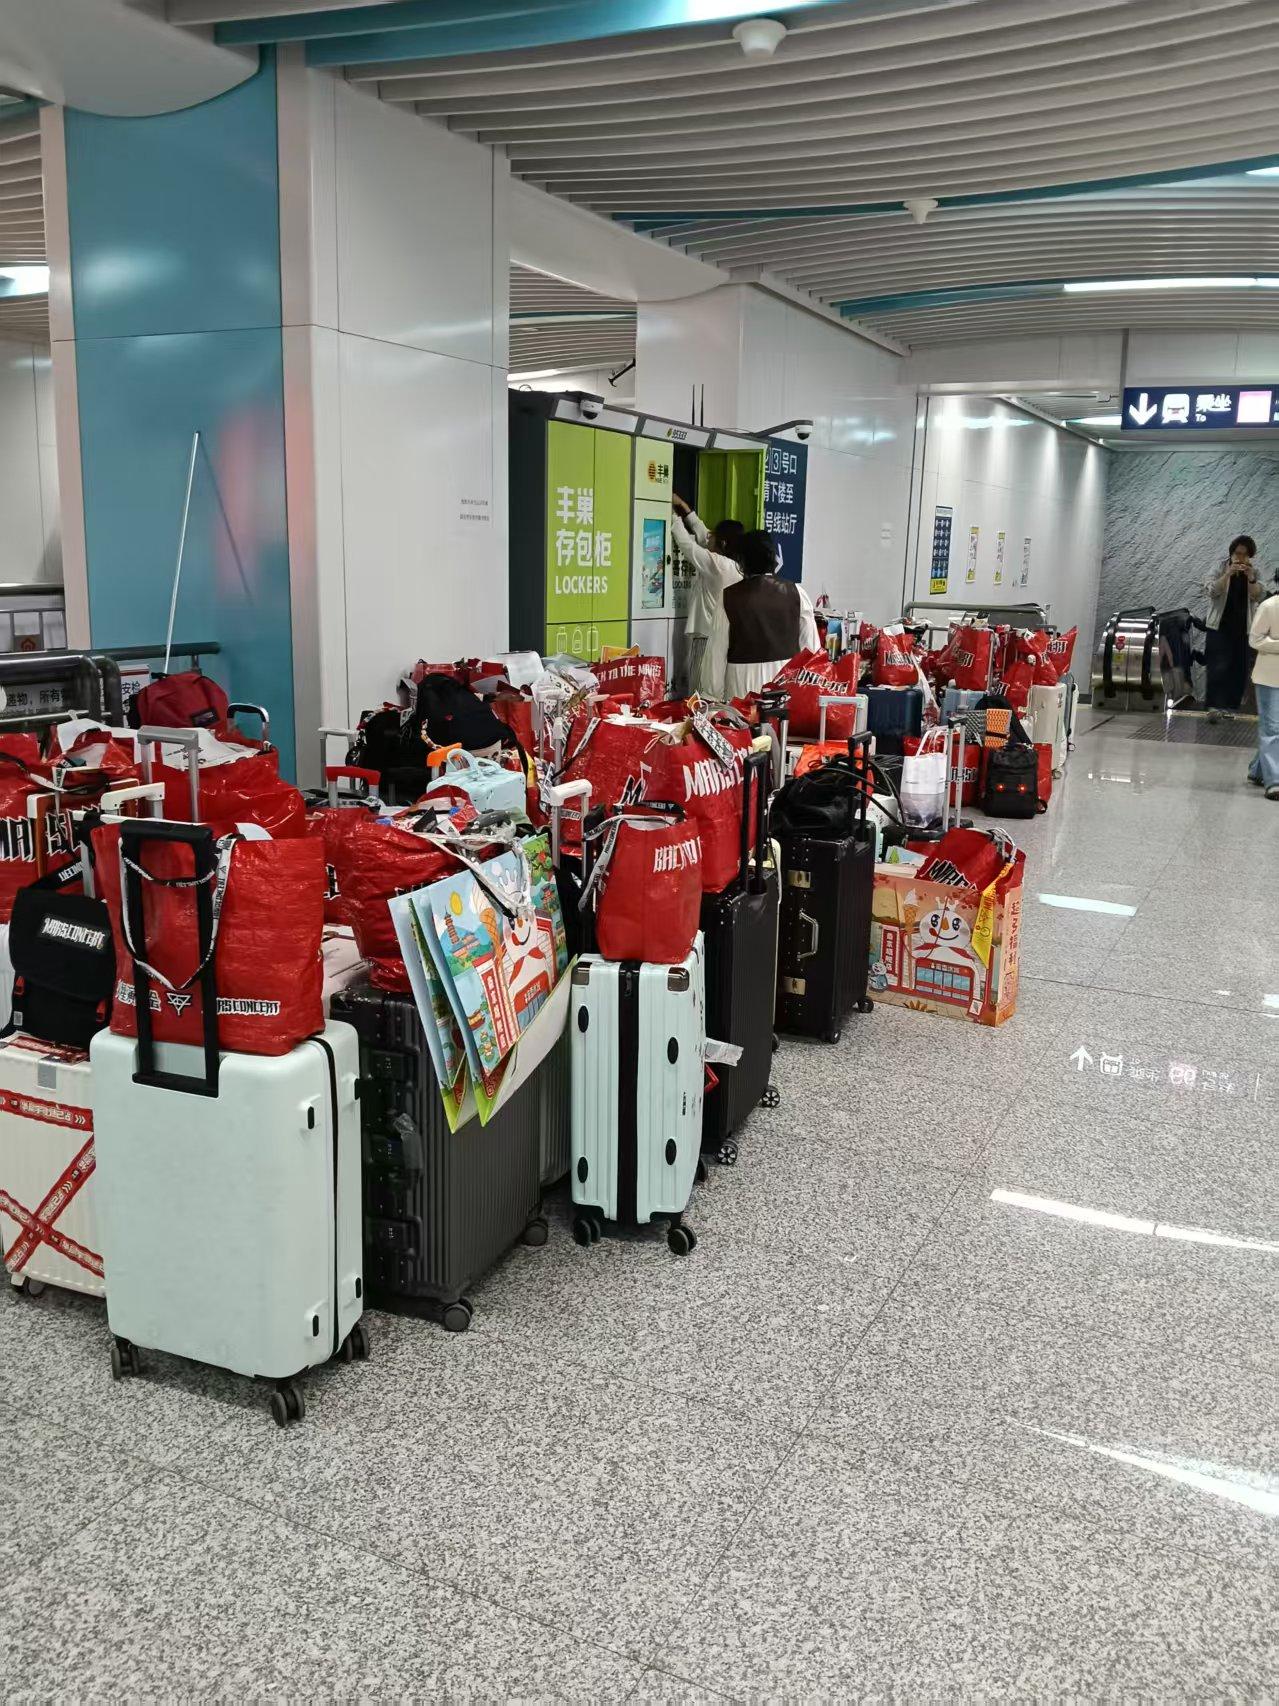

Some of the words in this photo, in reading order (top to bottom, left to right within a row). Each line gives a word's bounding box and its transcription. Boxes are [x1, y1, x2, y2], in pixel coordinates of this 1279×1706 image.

[1195, 413, 1207, 422] To
[556, 486, 593, 524] 丰巢
[556, 529, 612, 567] 存包柜
[555, 576, 608, 595] LOCKERS
